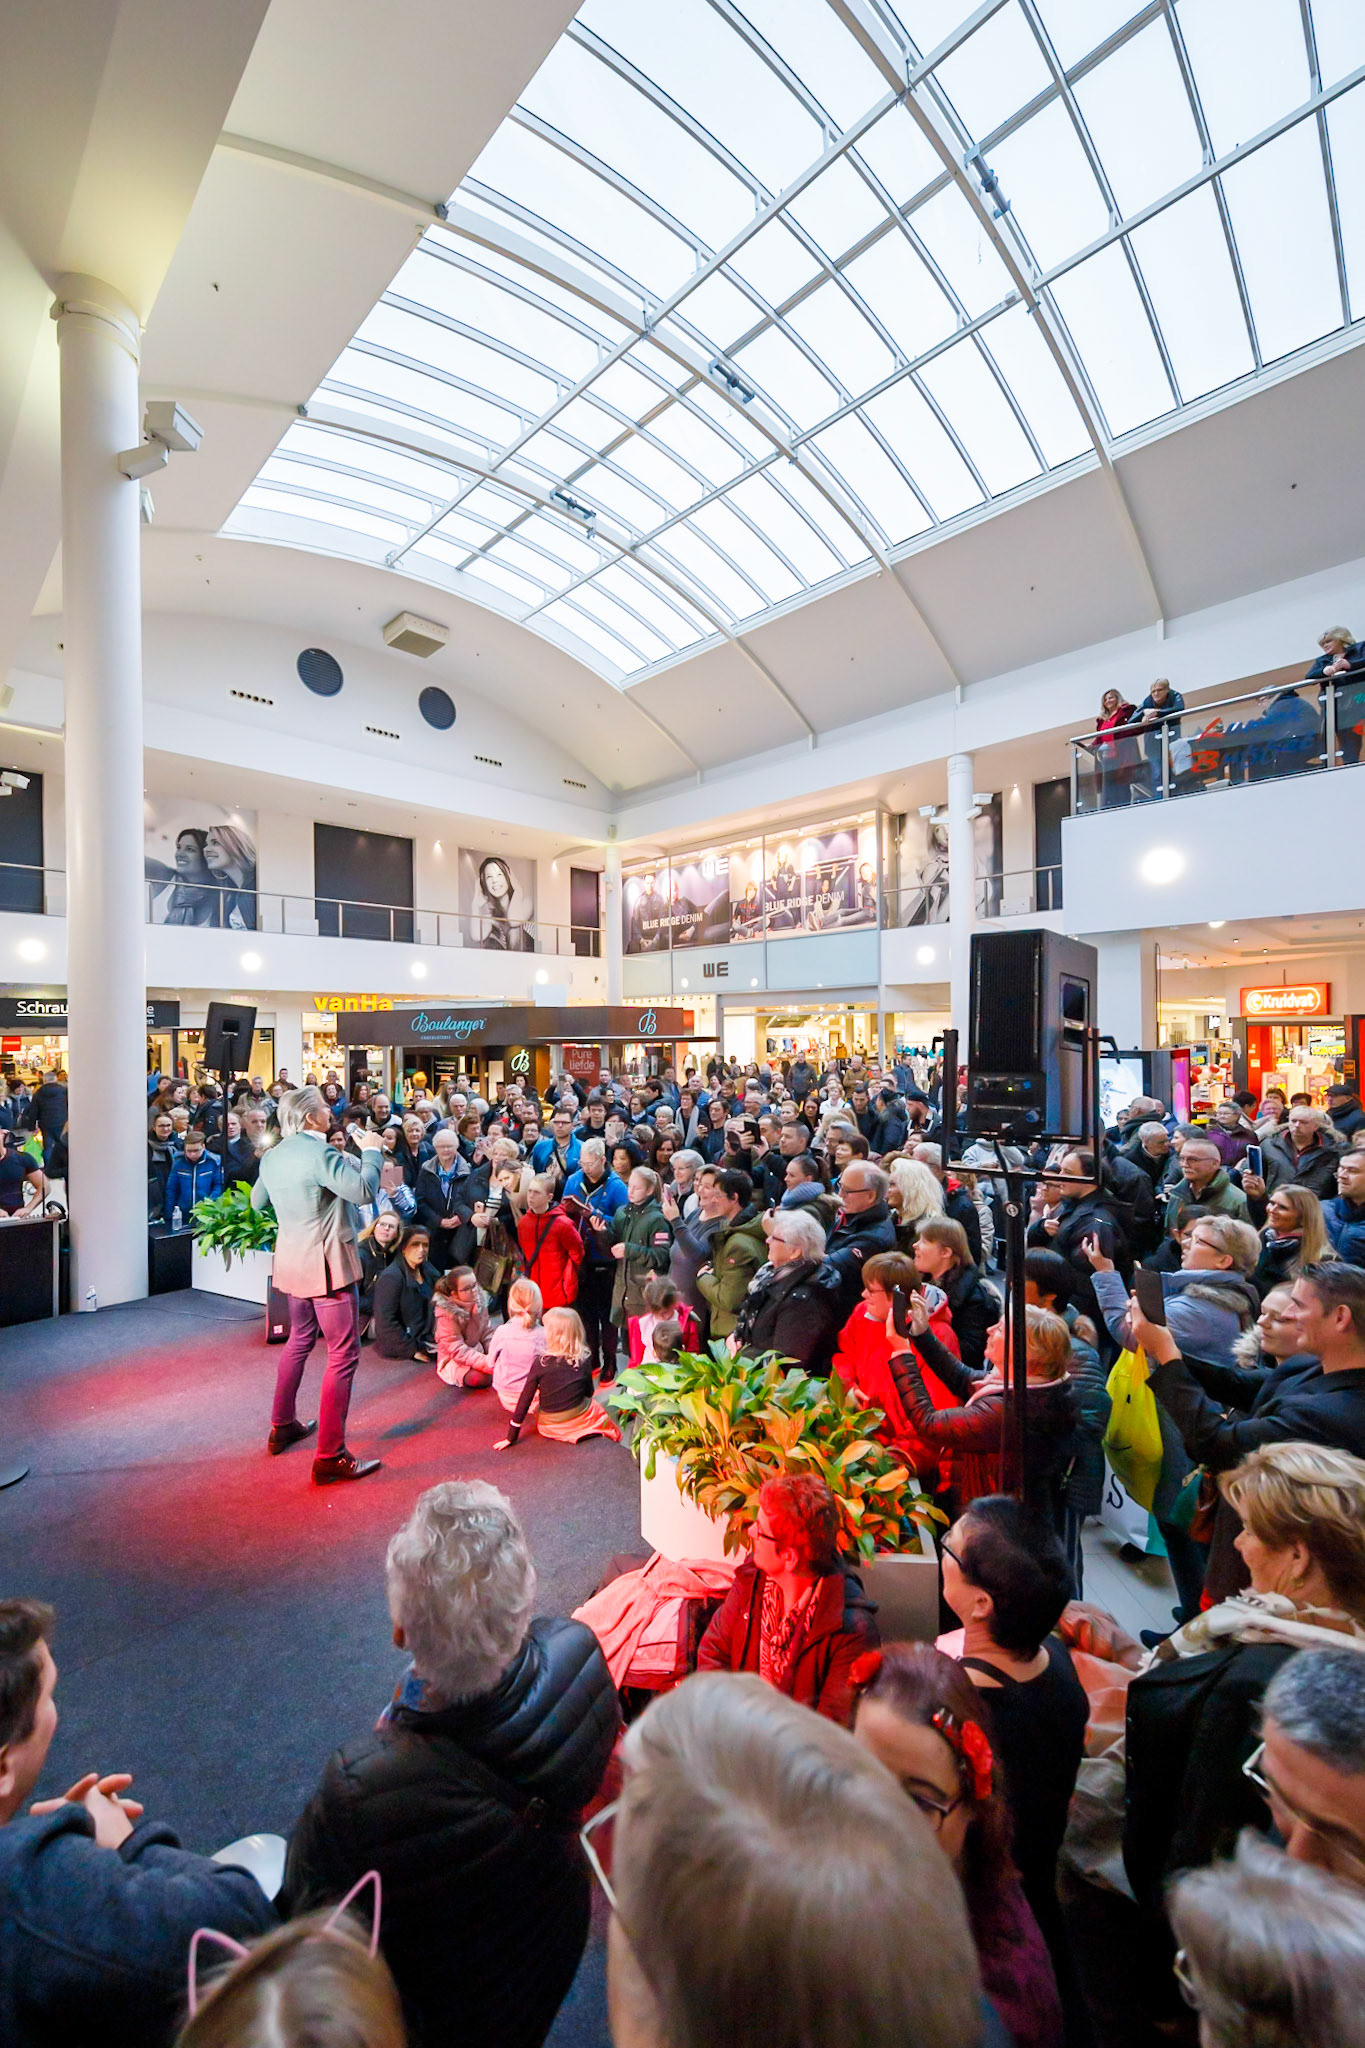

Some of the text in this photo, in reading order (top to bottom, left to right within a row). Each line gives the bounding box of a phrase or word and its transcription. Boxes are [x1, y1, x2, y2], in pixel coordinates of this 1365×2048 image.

[764, 891, 845, 912] BLUE RIDGE DENIM
[642, 912, 703, 930] BLUE RIDGE DENIM
[703, 961, 729, 978] WE
[313, 994, 424, 1012] vanHa
[1262, 992, 1315, 1009] Kruidvat
[410, 1012, 486, 1040] Boulanger
[571, 1049, 592, 1060] Pure
[569, 1059, 595, 1071] liefde
